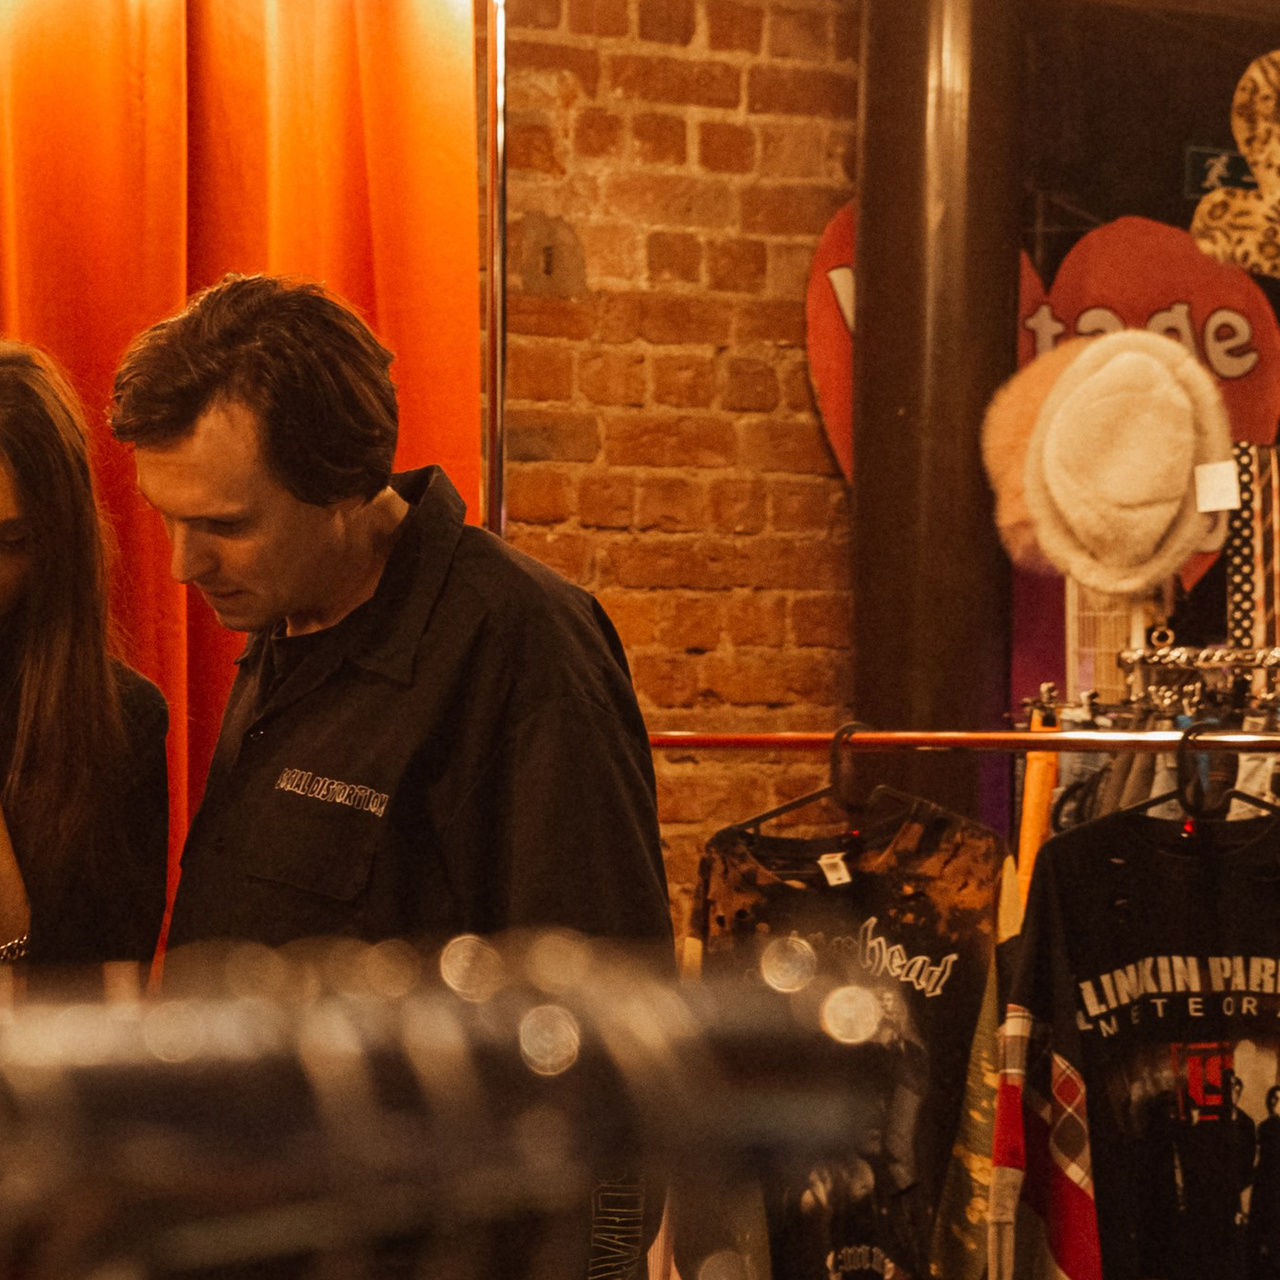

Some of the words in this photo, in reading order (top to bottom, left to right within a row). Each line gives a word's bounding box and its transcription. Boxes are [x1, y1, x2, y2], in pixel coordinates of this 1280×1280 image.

[1078, 955, 1202, 1017] LINKIN
[1208, 955, 1280, 994] PAR
[1076, 995, 1280, 1038] METEOR
